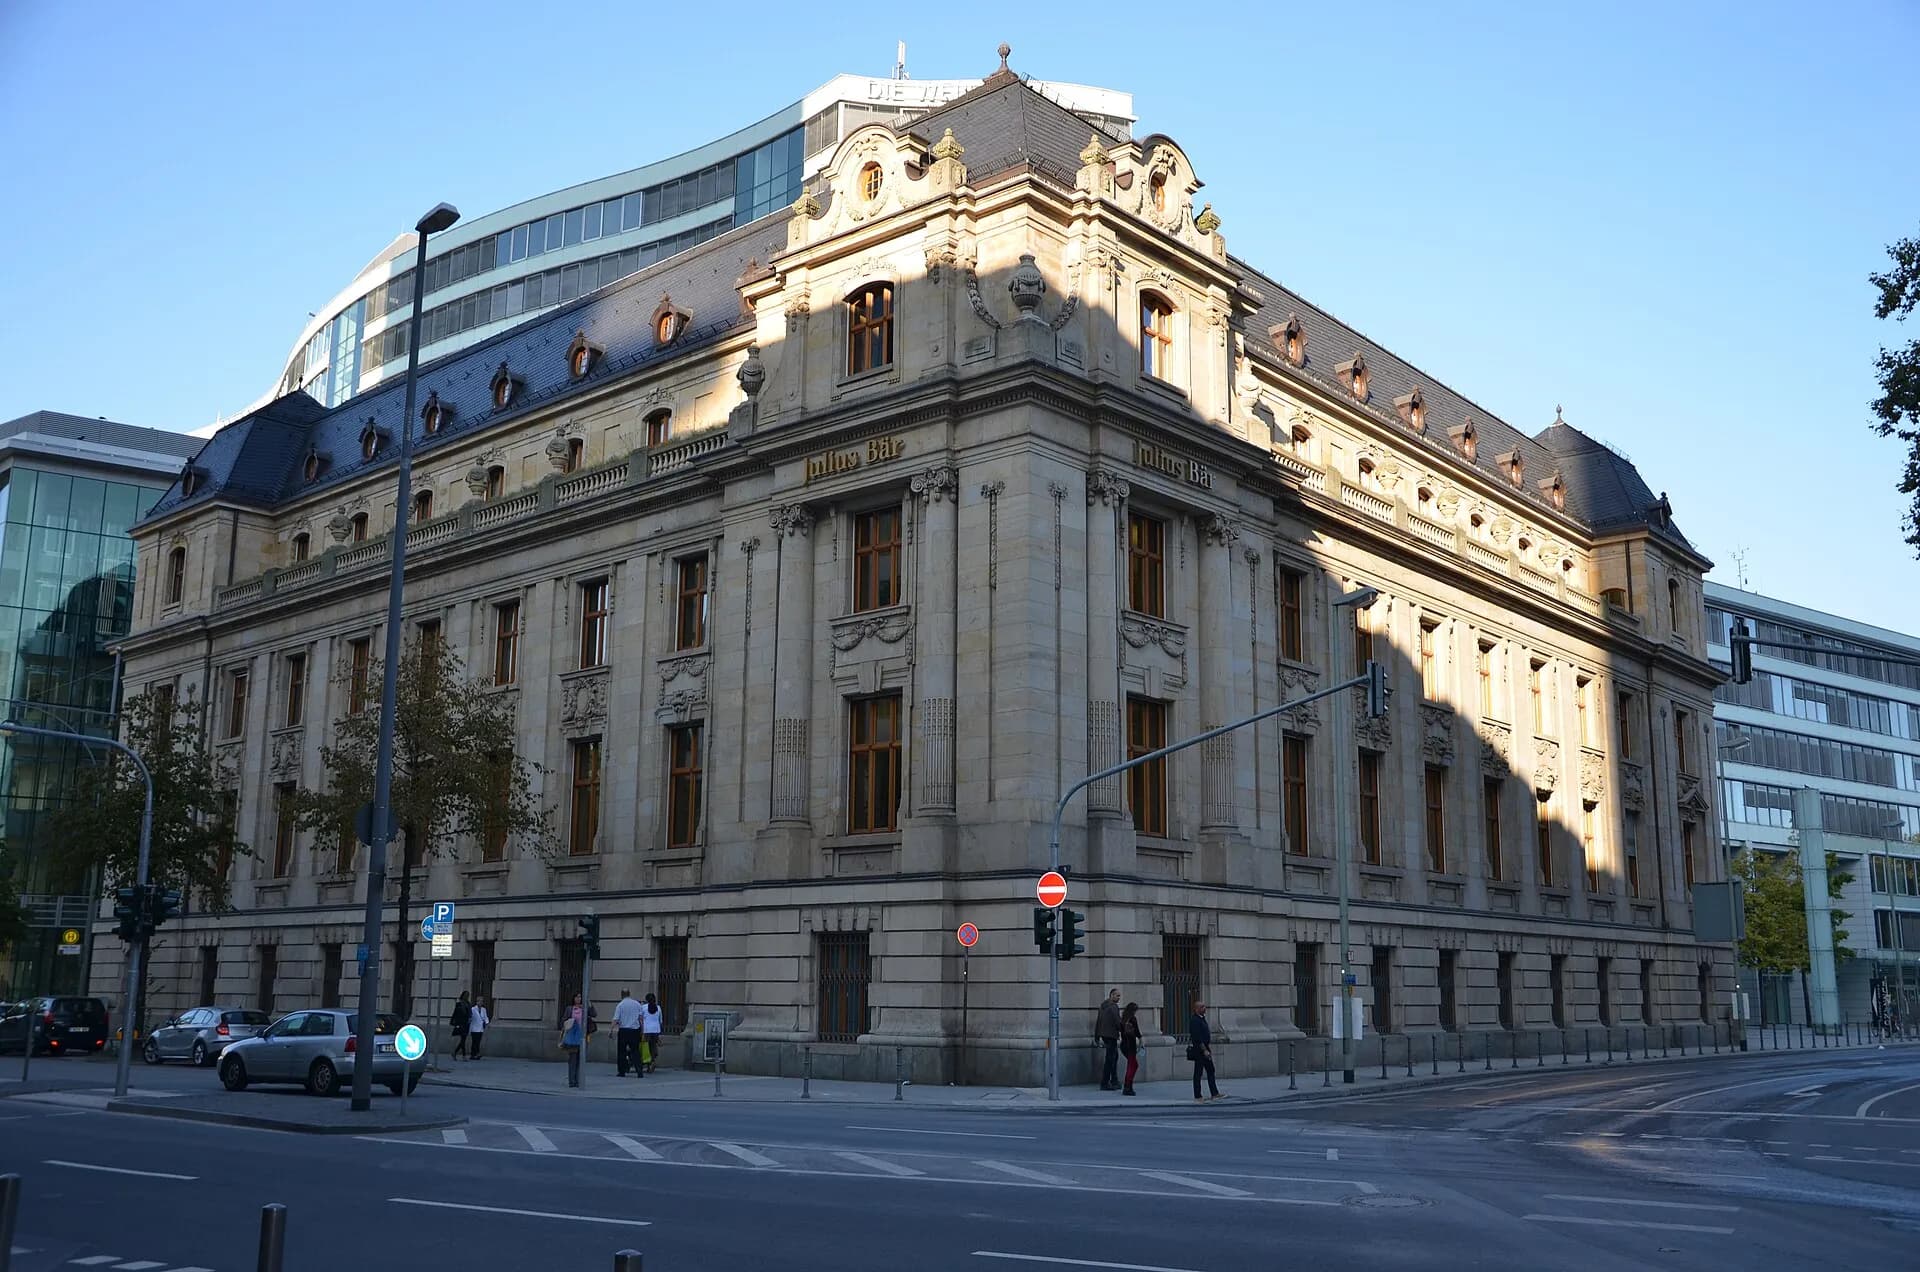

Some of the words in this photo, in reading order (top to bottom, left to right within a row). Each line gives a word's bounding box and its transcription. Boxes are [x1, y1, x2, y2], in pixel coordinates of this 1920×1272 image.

[868, 80, 905, 102] DIE
[803, 450, 859, 486] Julius
[866, 437, 905, 464] Bär
[1132, 440, 1185, 481] Julius
[1188, 460, 1216, 488] Bär
[438, 905, 449, 921] P
